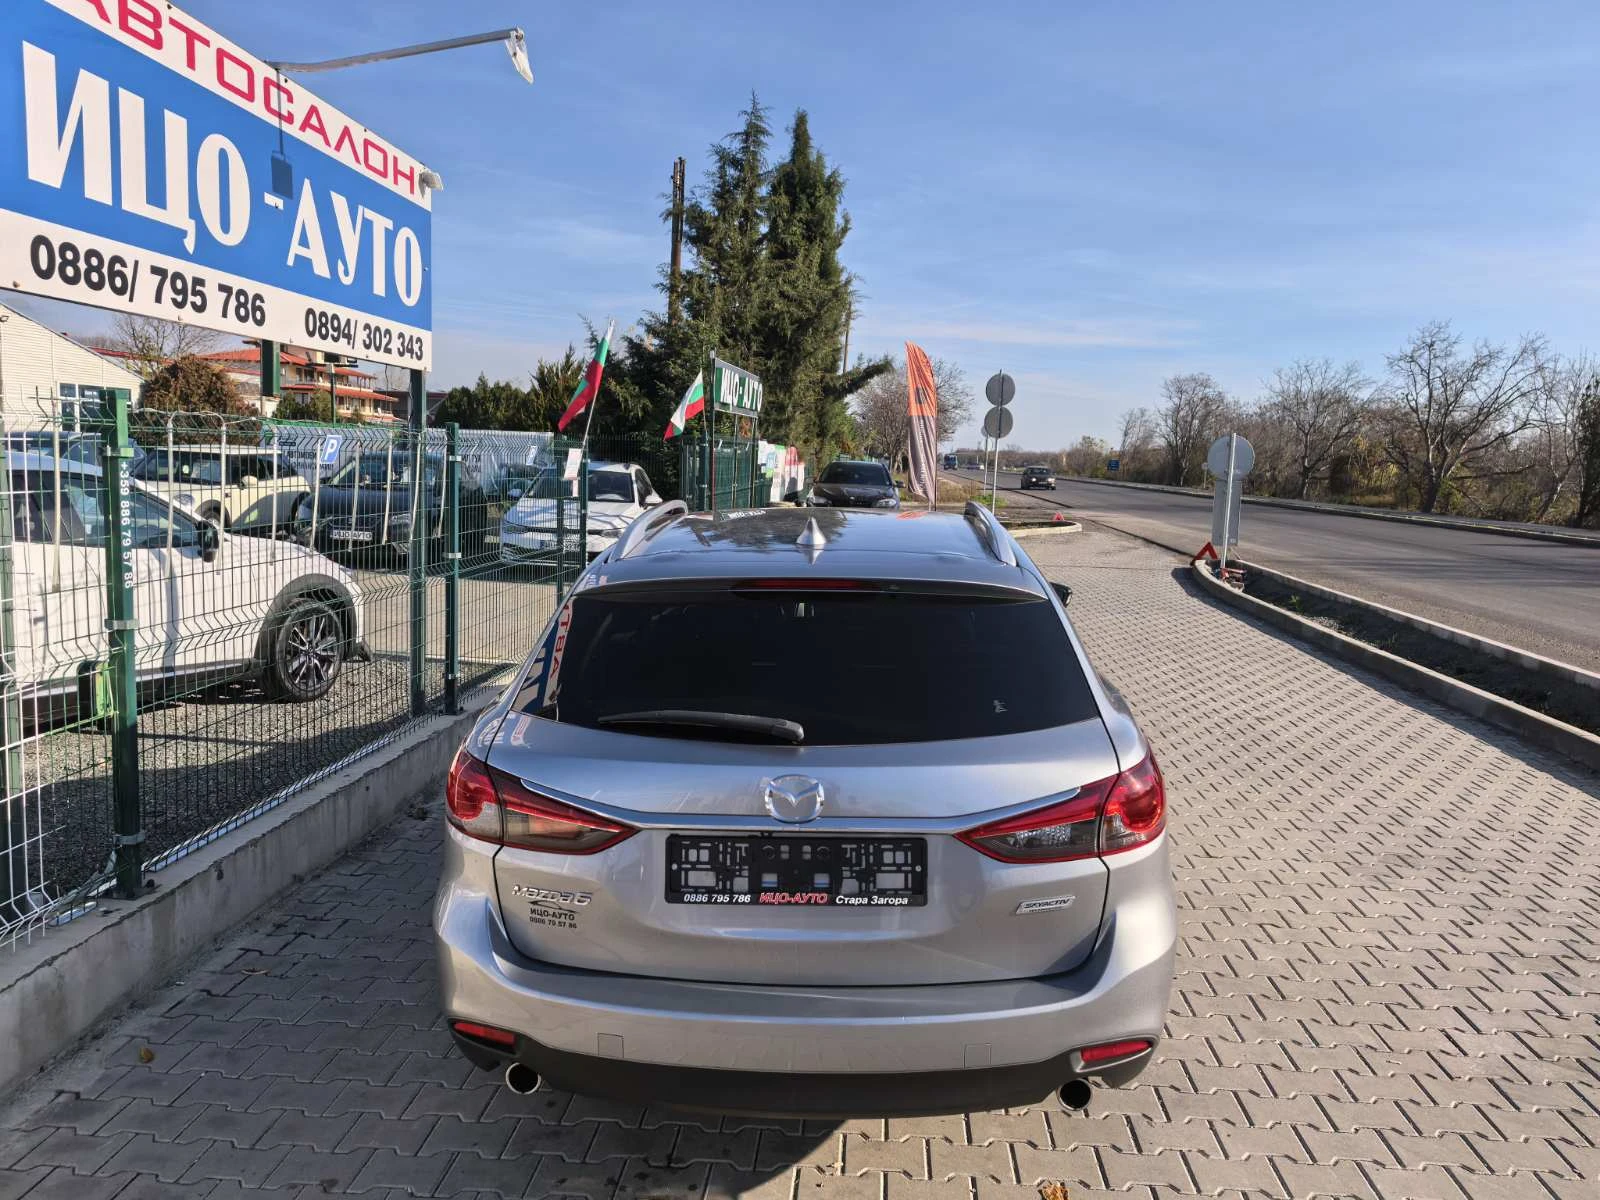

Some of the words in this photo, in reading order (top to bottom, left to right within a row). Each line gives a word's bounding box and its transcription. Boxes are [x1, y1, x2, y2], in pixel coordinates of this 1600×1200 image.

[30, 234, 139, 303] 0886/
[150, 264, 207, 313] 795
[217, 283, 266, 327] 786
[304, 307, 358, 350] 0894/
[362, 322, 393, 355] 302
[397, 331, 423, 361] 343
[530, 907, 575, 921] ИЦО-АУТО
[683, 893, 708, 902] 0886
[711, 894, 730, 903] 795
[732, 894, 752, 903] 786
[759, 892, 828, 905] ИЦО-АУТО
[836, 895, 868, 905] Стара
[871, 896, 909, 906] Загора
